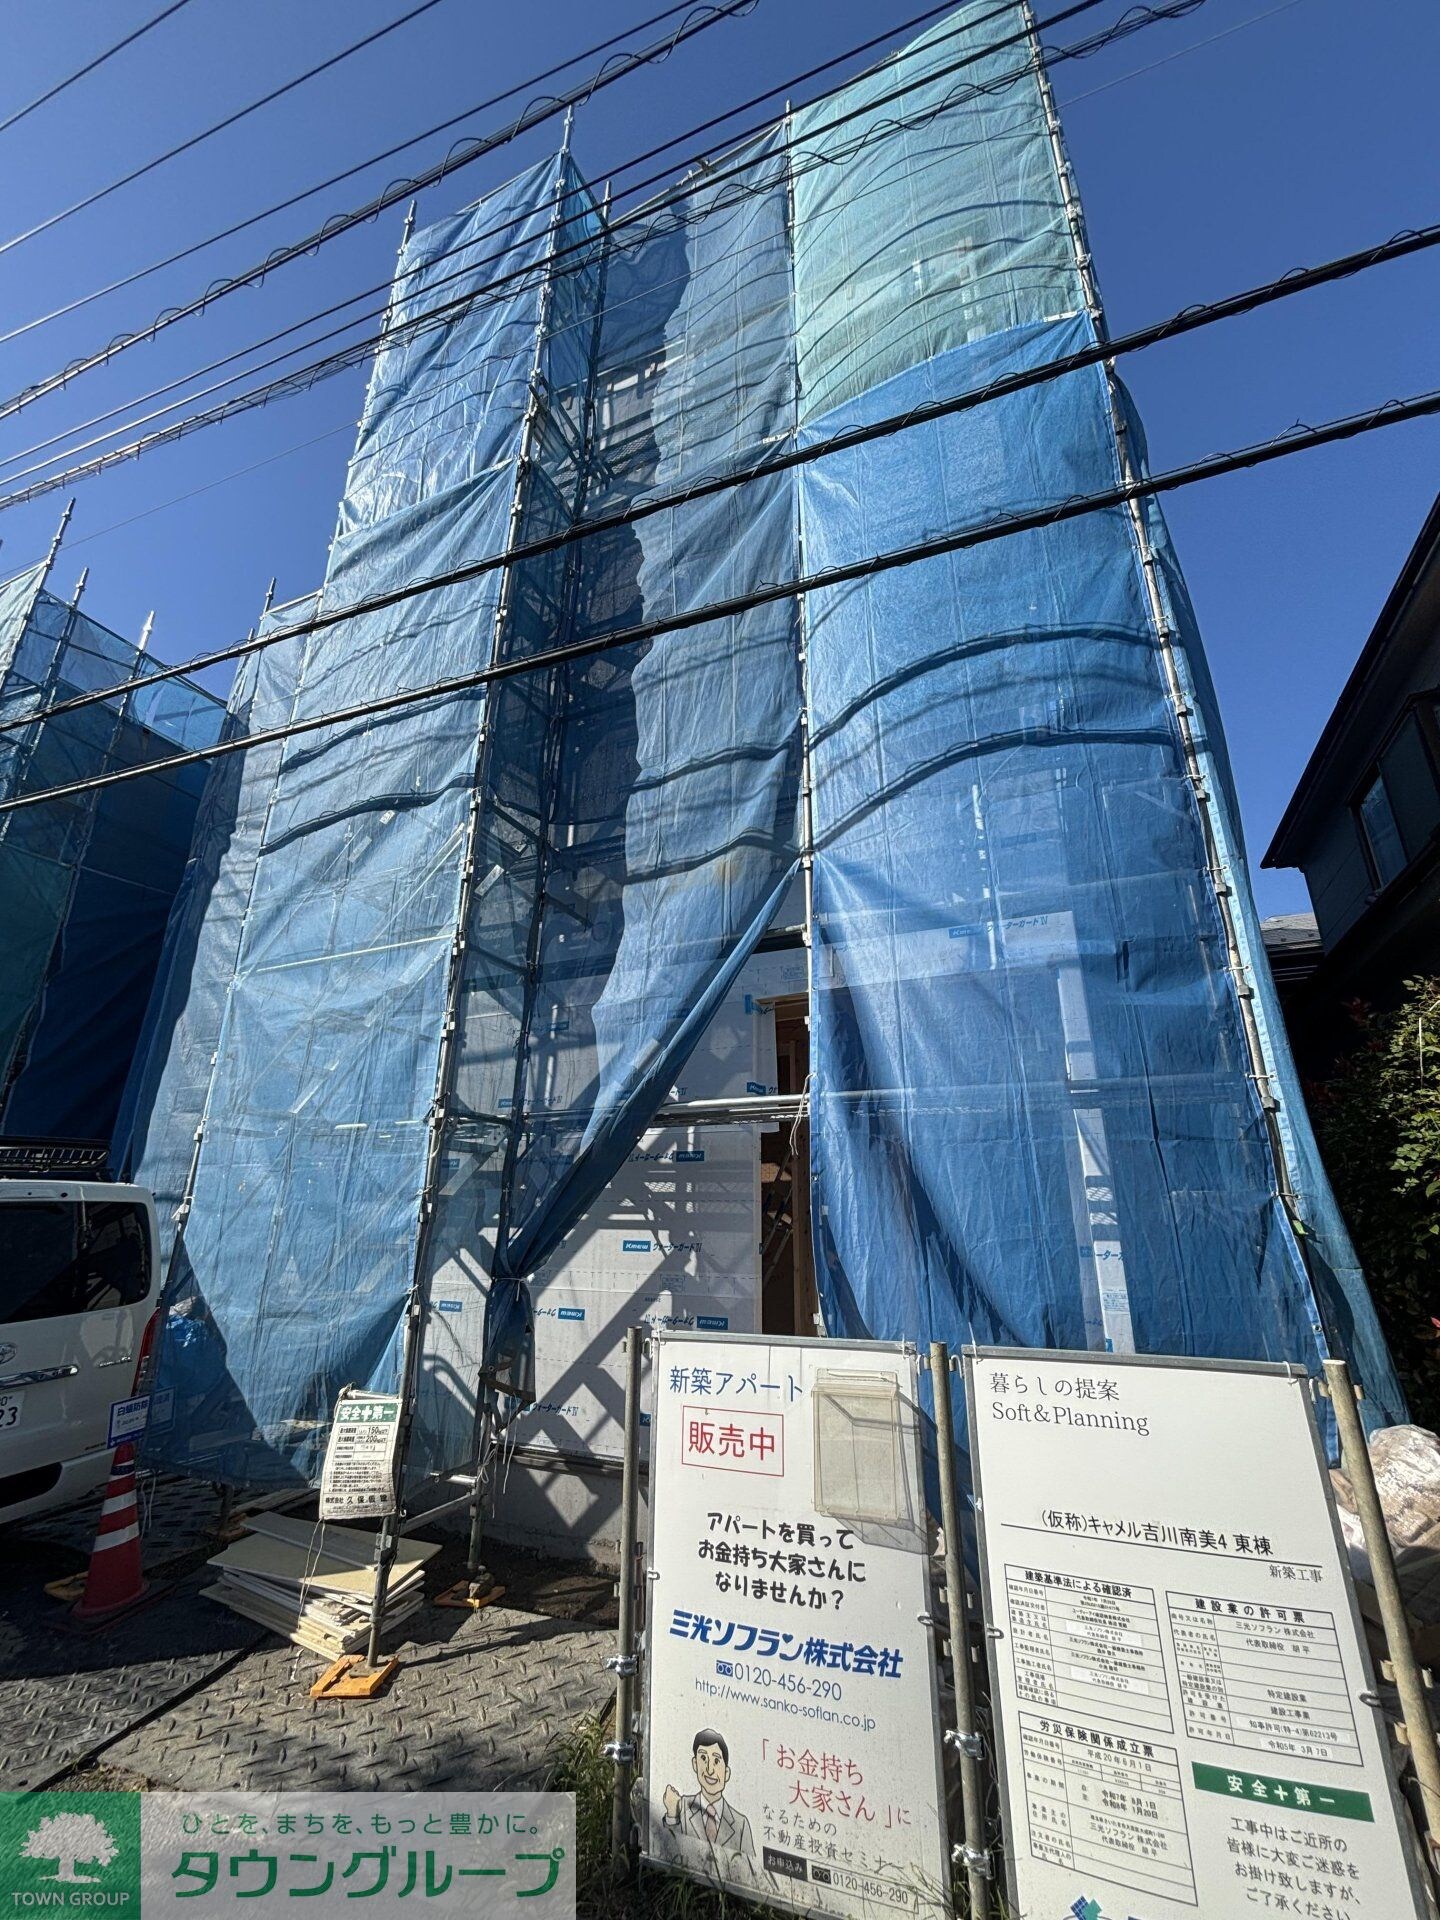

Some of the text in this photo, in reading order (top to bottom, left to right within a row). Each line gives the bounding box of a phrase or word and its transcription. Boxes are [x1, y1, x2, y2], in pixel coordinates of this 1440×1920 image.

[669, 1365, 803, 1402] 新築アパート
[990, 1372, 1120, 1401] 暮らしの提案
[992, 1402, 1150, 1436] Soft&Planning
[688, 1421, 775, 1461] 販売中
[706, 1512, 854, 1549] アパートを買って
[1235, 1533, 1274, 1557] 東棟
[698, 1539, 866, 1582] お金持ち大家さんに
[1269, 1564, 1323, 1584] 新築工事
[715, 1571, 844, 1610] なりませんか？
[1024, 1569, 1132, 1598] 建築基準法による確認済
[1194, 1597, 1305, 1623] 建設業の許可票
[669, 1609, 904, 1678] 三光ソフラン株式会社
[734, 1663, 842, 1701] 0120-456-290
[695, 1677, 877, 1731] http://www.sanko-soflan.co.jp
[1039, 1719, 1154, 1758] 労災保険関係成立票
[762, 1738, 863, 1786] 「お金持ち
[762, 1803, 837, 1836] なるための
[1231, 1816, 1348, 1852] 工事中はご近所の
[1226, 1837, 1361, 1880] 皆様に大変ご迷惑を
[833, 1871, 908, 1905] 0120-456-290
